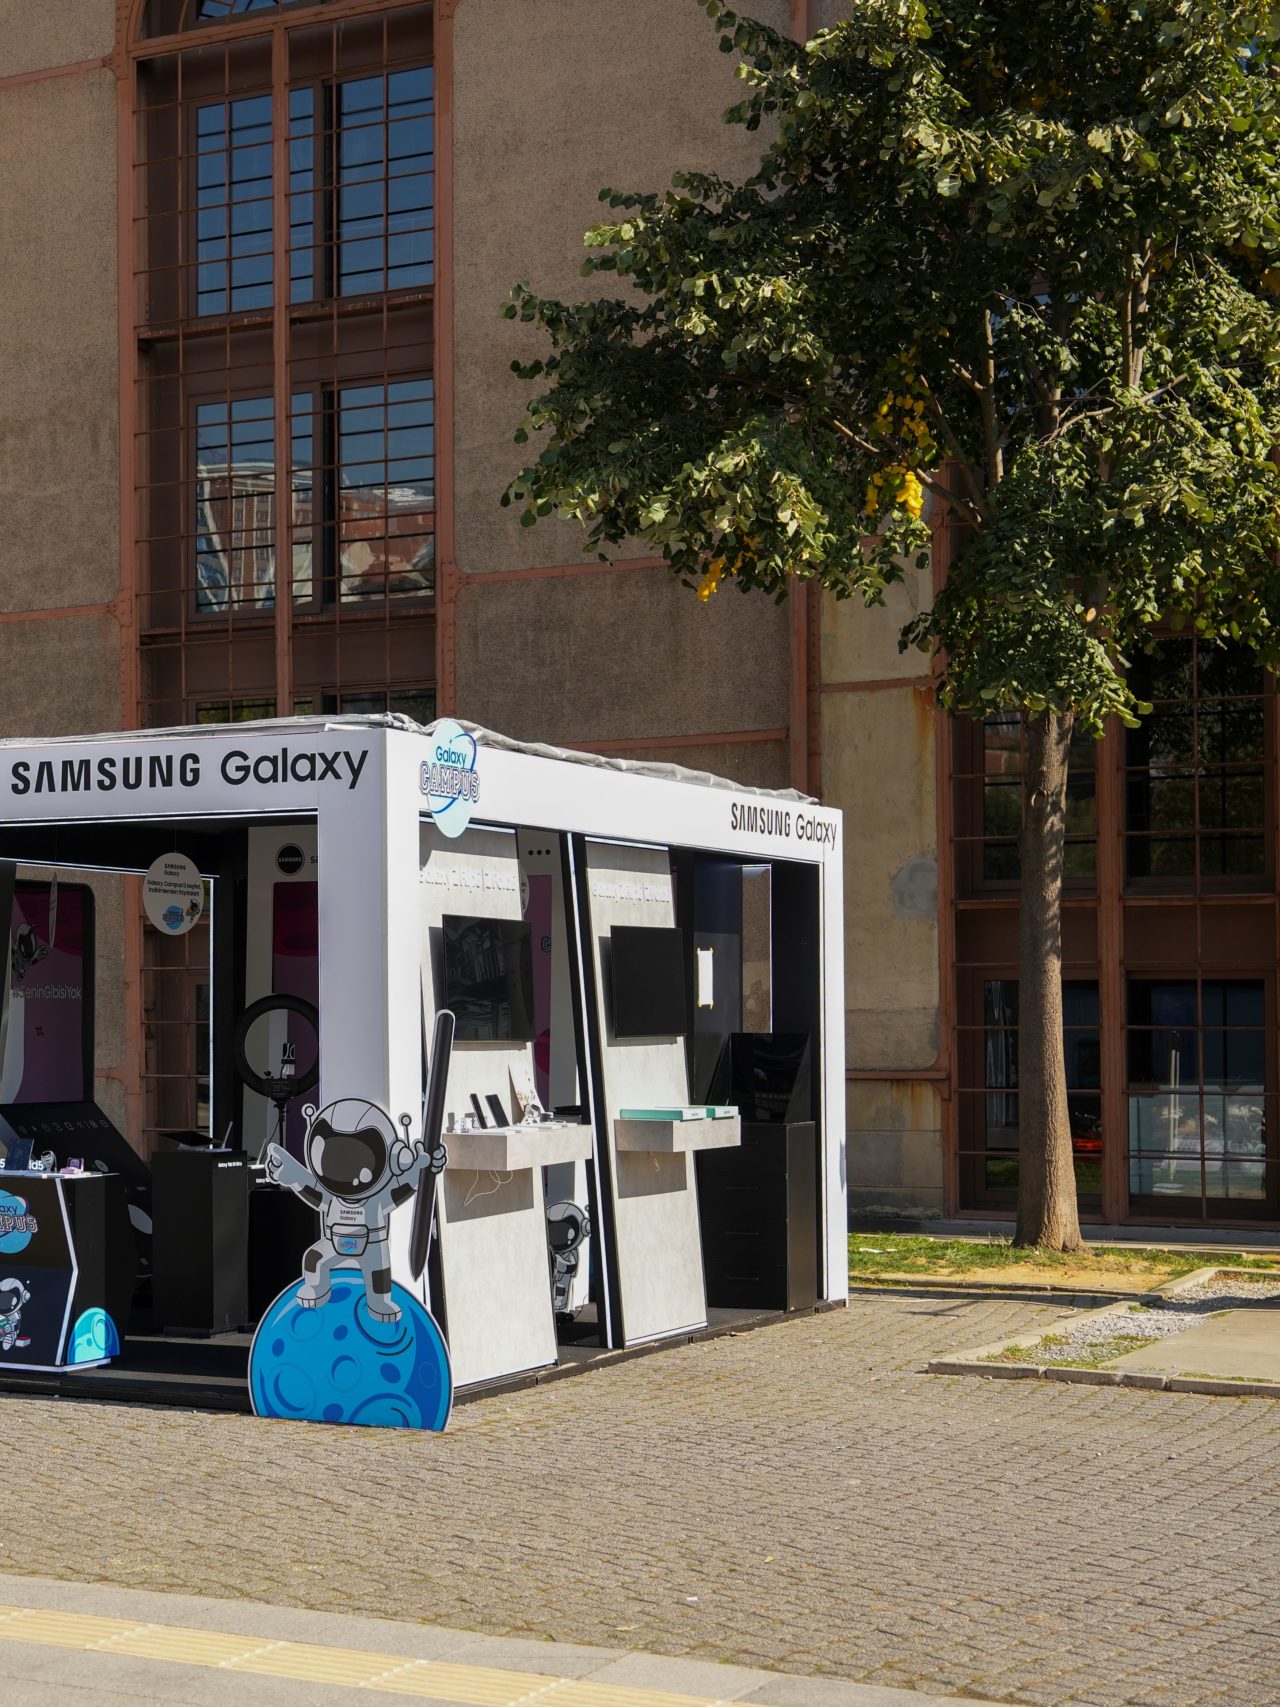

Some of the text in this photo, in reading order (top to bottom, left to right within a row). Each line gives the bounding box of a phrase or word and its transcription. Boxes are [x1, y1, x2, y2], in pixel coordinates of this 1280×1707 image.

[10, 747, 369, 795] SAMSUNG Galaxy
[436, 746, 467, 769] Galaxy
[419, 761, 480, 804] CAMPUS
[731, 802, 837, 851] SAMSUNG Galaxy
